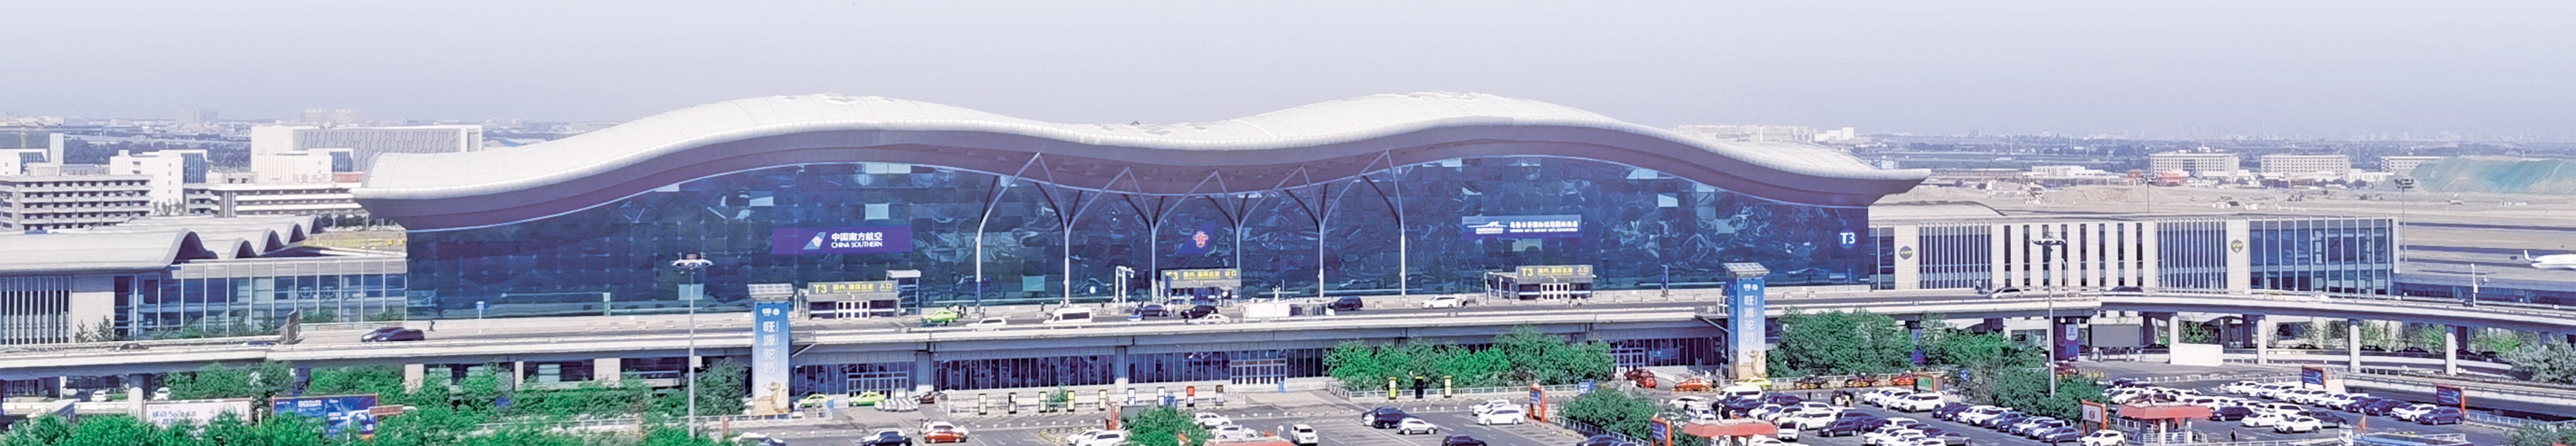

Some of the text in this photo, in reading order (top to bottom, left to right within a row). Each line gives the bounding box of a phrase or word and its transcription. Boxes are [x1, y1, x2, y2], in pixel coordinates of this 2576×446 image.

[831, 232, 882, 241] 中国南方航空
[1840, 232, 1855, 244] T3
[1521, 268, 1534, 277] T3
[813, 284, 828, 293] T3
[1744, 295, 1755, 343] 旺源驼奶
[763, 321, 776, 374] 旺源驼奶
